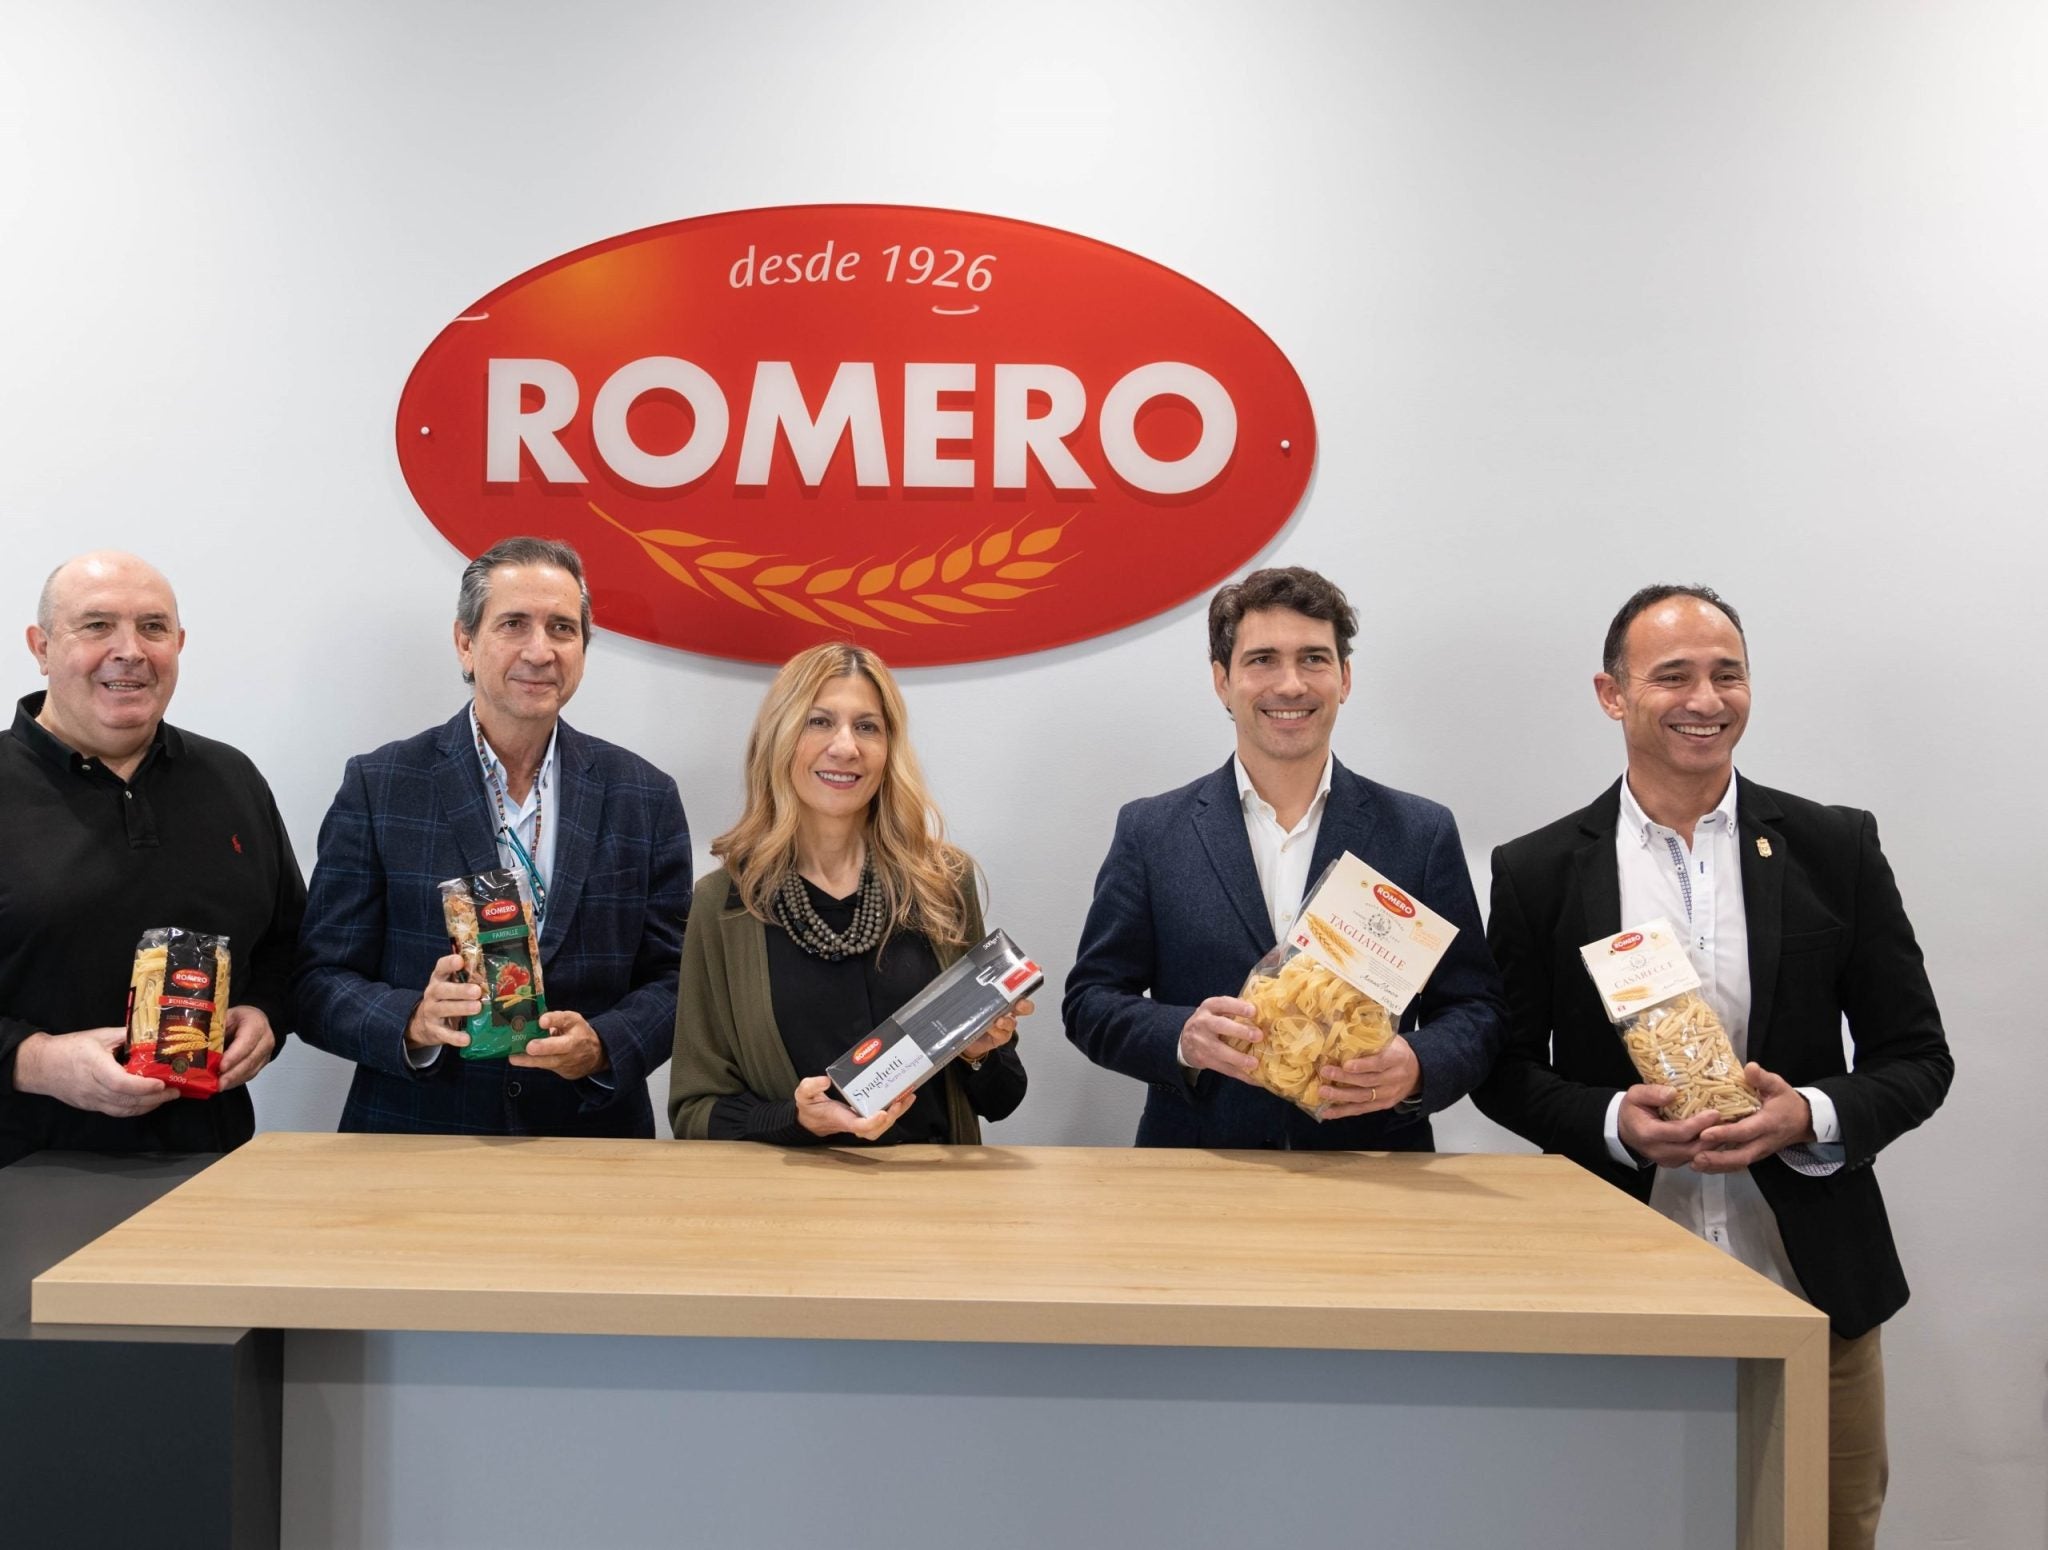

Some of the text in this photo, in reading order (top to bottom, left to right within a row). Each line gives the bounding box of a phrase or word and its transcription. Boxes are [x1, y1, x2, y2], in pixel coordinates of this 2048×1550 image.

[729, 240, 998, 293] desde 1926
[486, 356, 1238, 495] ROMERO
[485, 905, 516, 917] ROMERO
[1376, 887, 1413, 915] ROMERO
[491, 928, 519, 940] FARFALLE
[1329, 913, 1407, 971] TAGLIATELLE
[1614, 935, 1641, 948] ROMERO
[175, 973, 208, 984] ROMERO
[854, 1040, 880, 1062] ROMERO
[852, 1056, 904, 1102] Spaghetti
